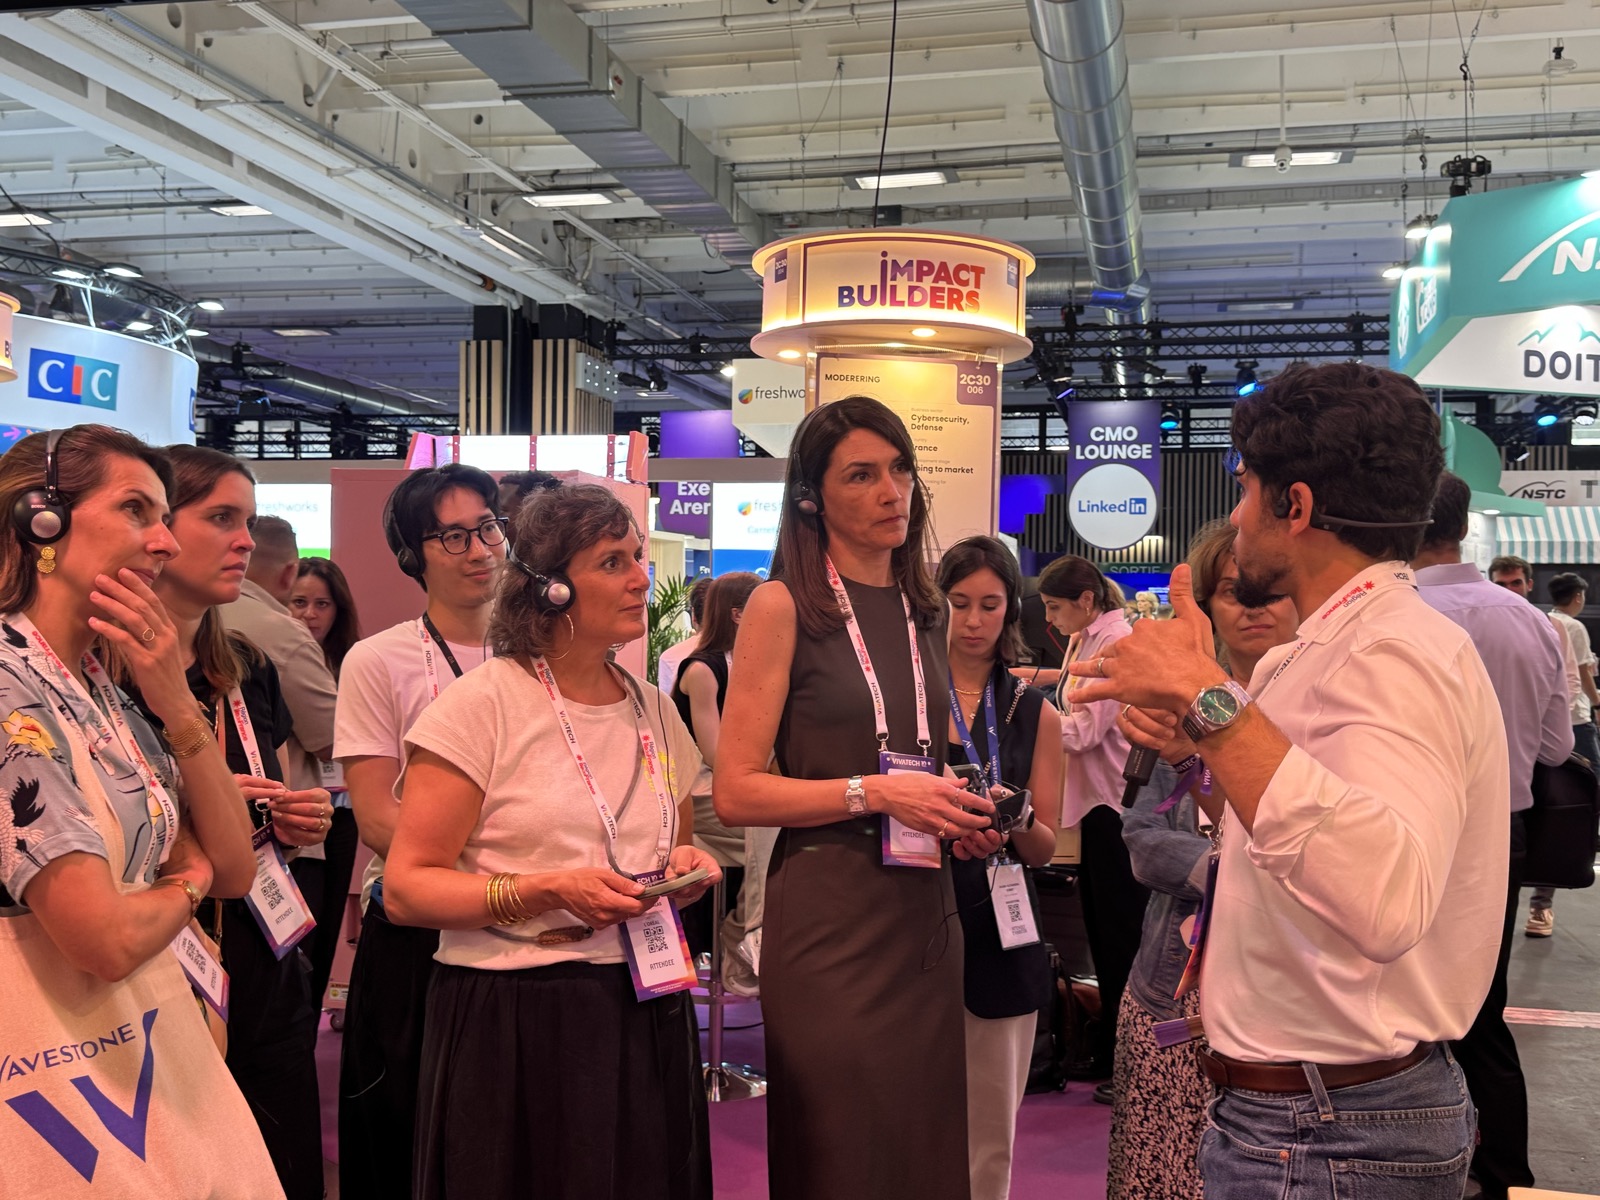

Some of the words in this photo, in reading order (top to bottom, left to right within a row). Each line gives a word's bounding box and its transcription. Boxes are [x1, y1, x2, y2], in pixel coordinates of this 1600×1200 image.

[1552, 236, 1600, 275] N
[37, 359, 113, 402] CIC
[824, 373, 881, 384] MODERERING
[959, 373, 992, 386] 2C30
[966, 385, 984, 395] 006
[910, 414, 970, 426] Cybersecurity,
[910, 423, 944, 432] Defense
[1089, 425, 1139, 442] CMO
[913, 444, 939, 452] rance
[1075, 444, 1153, 460] LOUNGE
[916, 464, 933, 475] oing
[934, 465, 943, 473] to
[944, 466, 974, 474] market
[1521, 488, 1566, 499] NSTC
[249, 750, 263, 778] VIVATEC
[891, 757, 921, 768] VIVATECH
[649, 958, 675, 971] ATTENDEE
